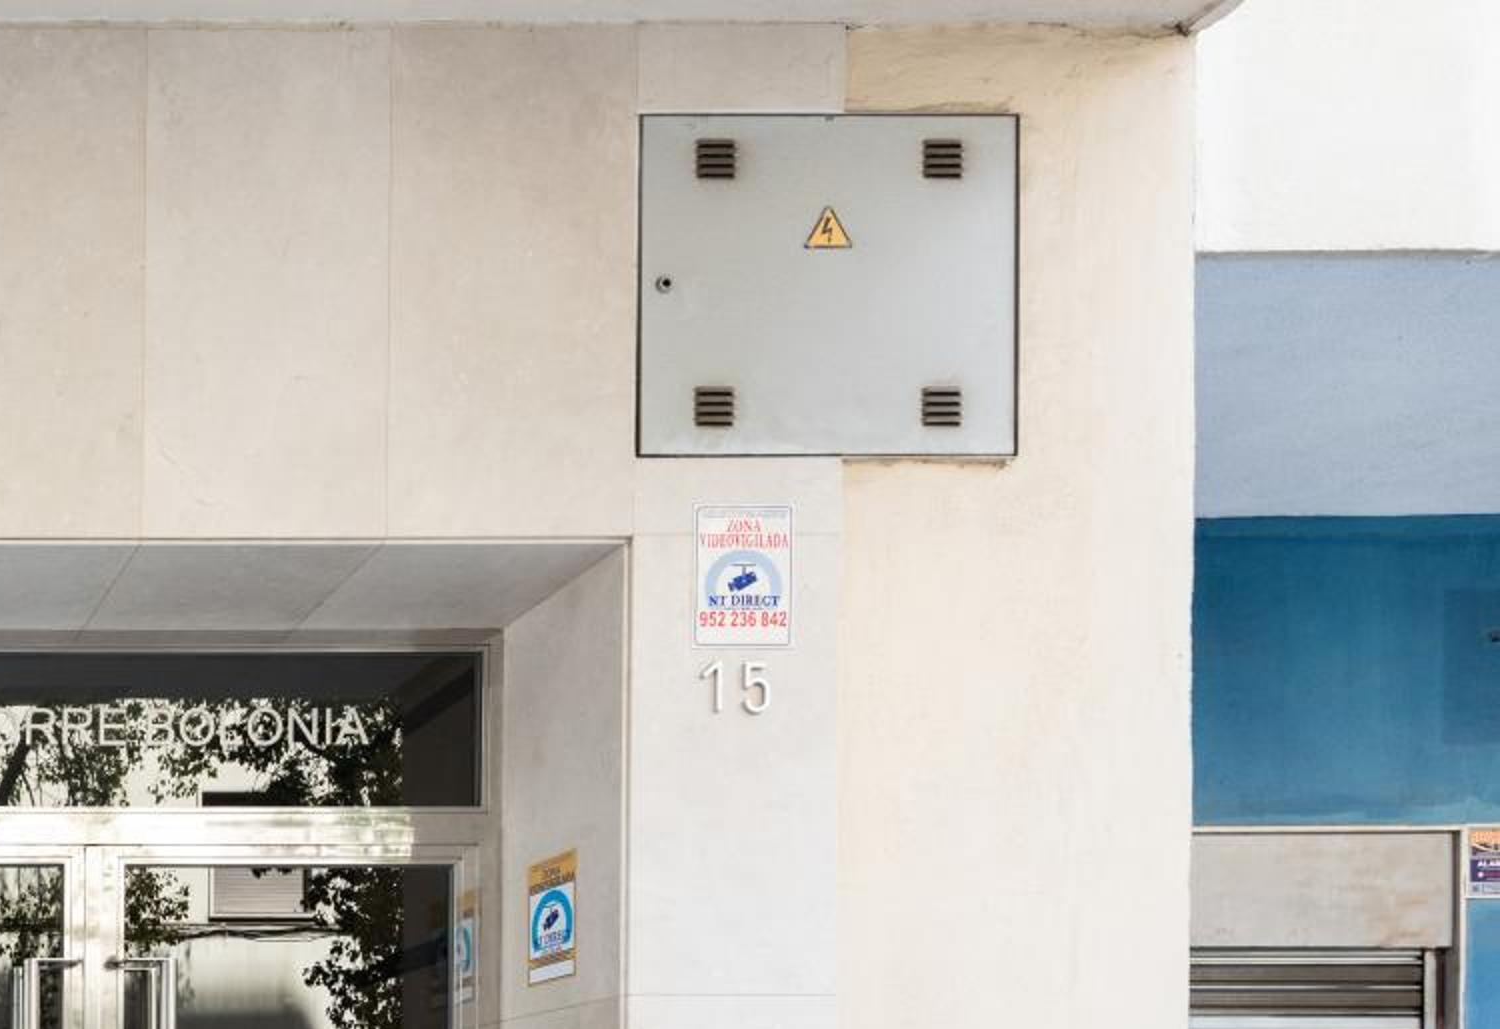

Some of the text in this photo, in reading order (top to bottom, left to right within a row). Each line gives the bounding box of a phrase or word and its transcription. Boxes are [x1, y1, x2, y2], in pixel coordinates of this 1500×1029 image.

[726, 518, 761, 532] ZONA
[699, 532, 789, 549] VIDEOVIGILADA
[708, 594, 781, 607] NT DIRECT
[699, 611, 787, 627] 952 236 842
[699, 660, 771, 715] 15
[145, 707, 369, 747] BOLONIA
